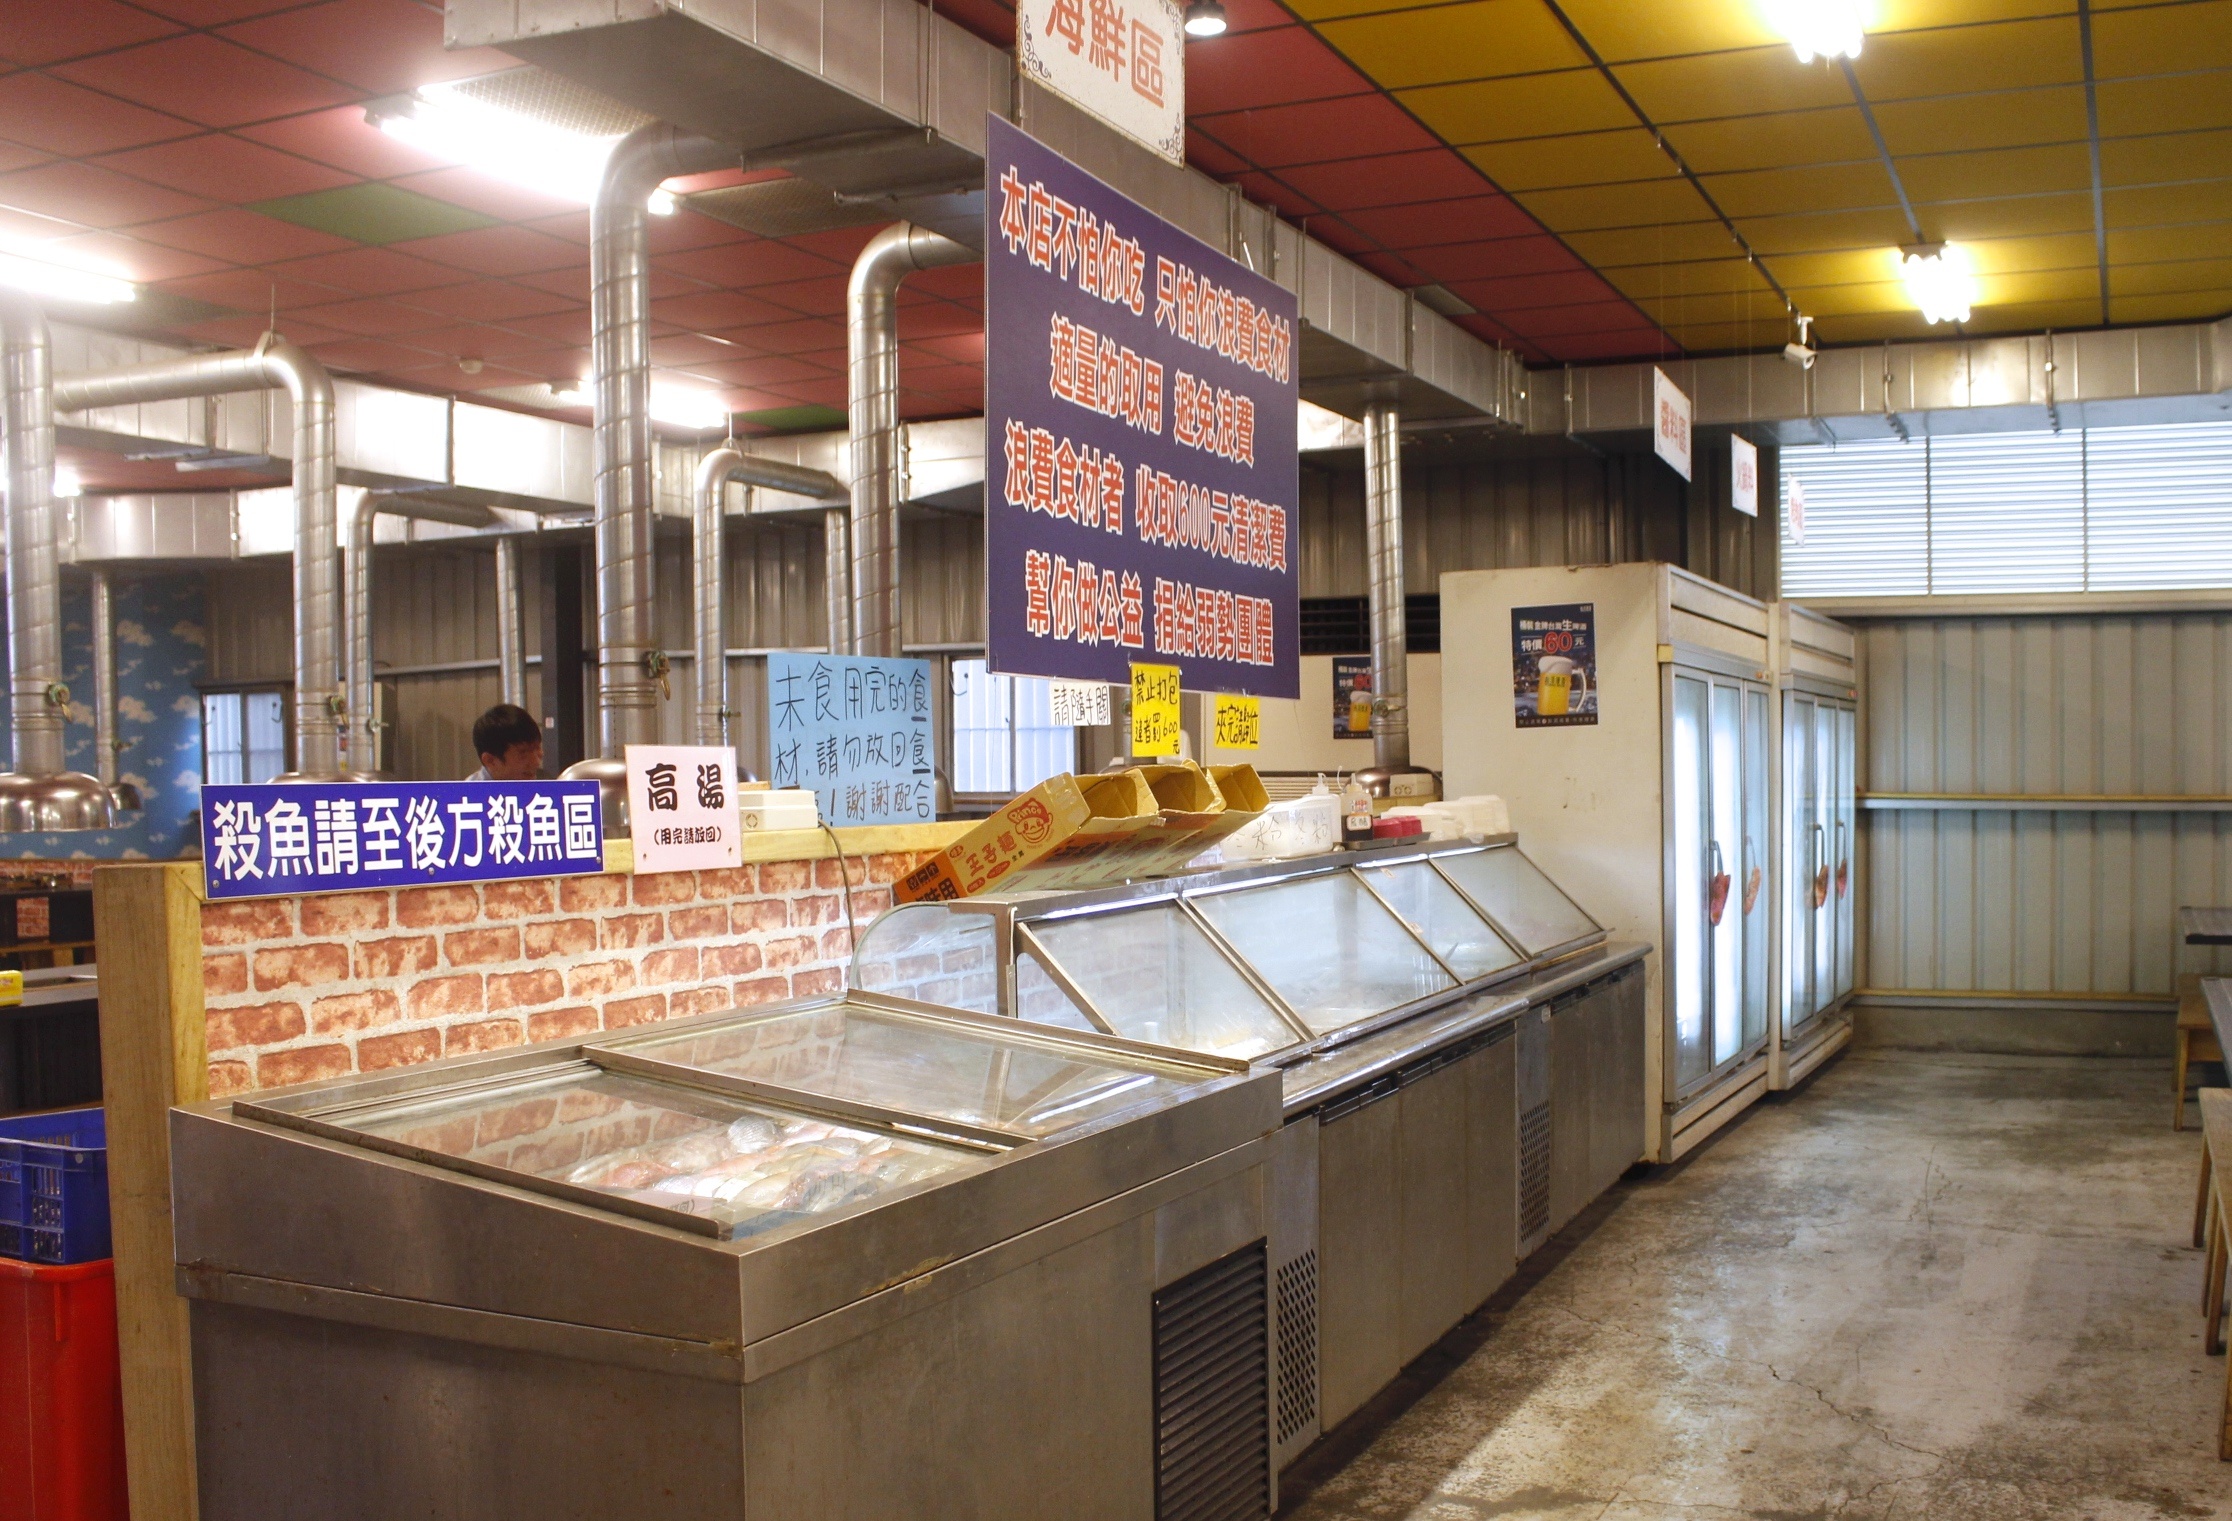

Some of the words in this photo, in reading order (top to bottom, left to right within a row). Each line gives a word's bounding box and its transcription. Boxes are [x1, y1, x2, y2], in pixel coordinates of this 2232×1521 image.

[1045, 0, 1164, 109] 海鮮區
[1000, 164, 1145, 316] 本店不怕你吃
[1155, 255, 1290, 384] 只怕你浪費食材
[1050, 311, 1163, 435] 適量的取用
[1174, 368, 1254, 468] 避免浪費
[1004, 417, 1124, 535] 浪費食材者
[1136, 463, 1287, 574] 收取600元清潔費
[1025, 549, 1144, 648] 幫你做公益
[1153, 577, 1274, 666] 捐給弱勢團體
[775, 660, 929, 731] 未食用完的食
[1135, 670, 1178, 706] 禁止打包
[213, 793, 598, 880] 殺魚請至後方殺魚區
[645, 763, 724, 811] 高湯
